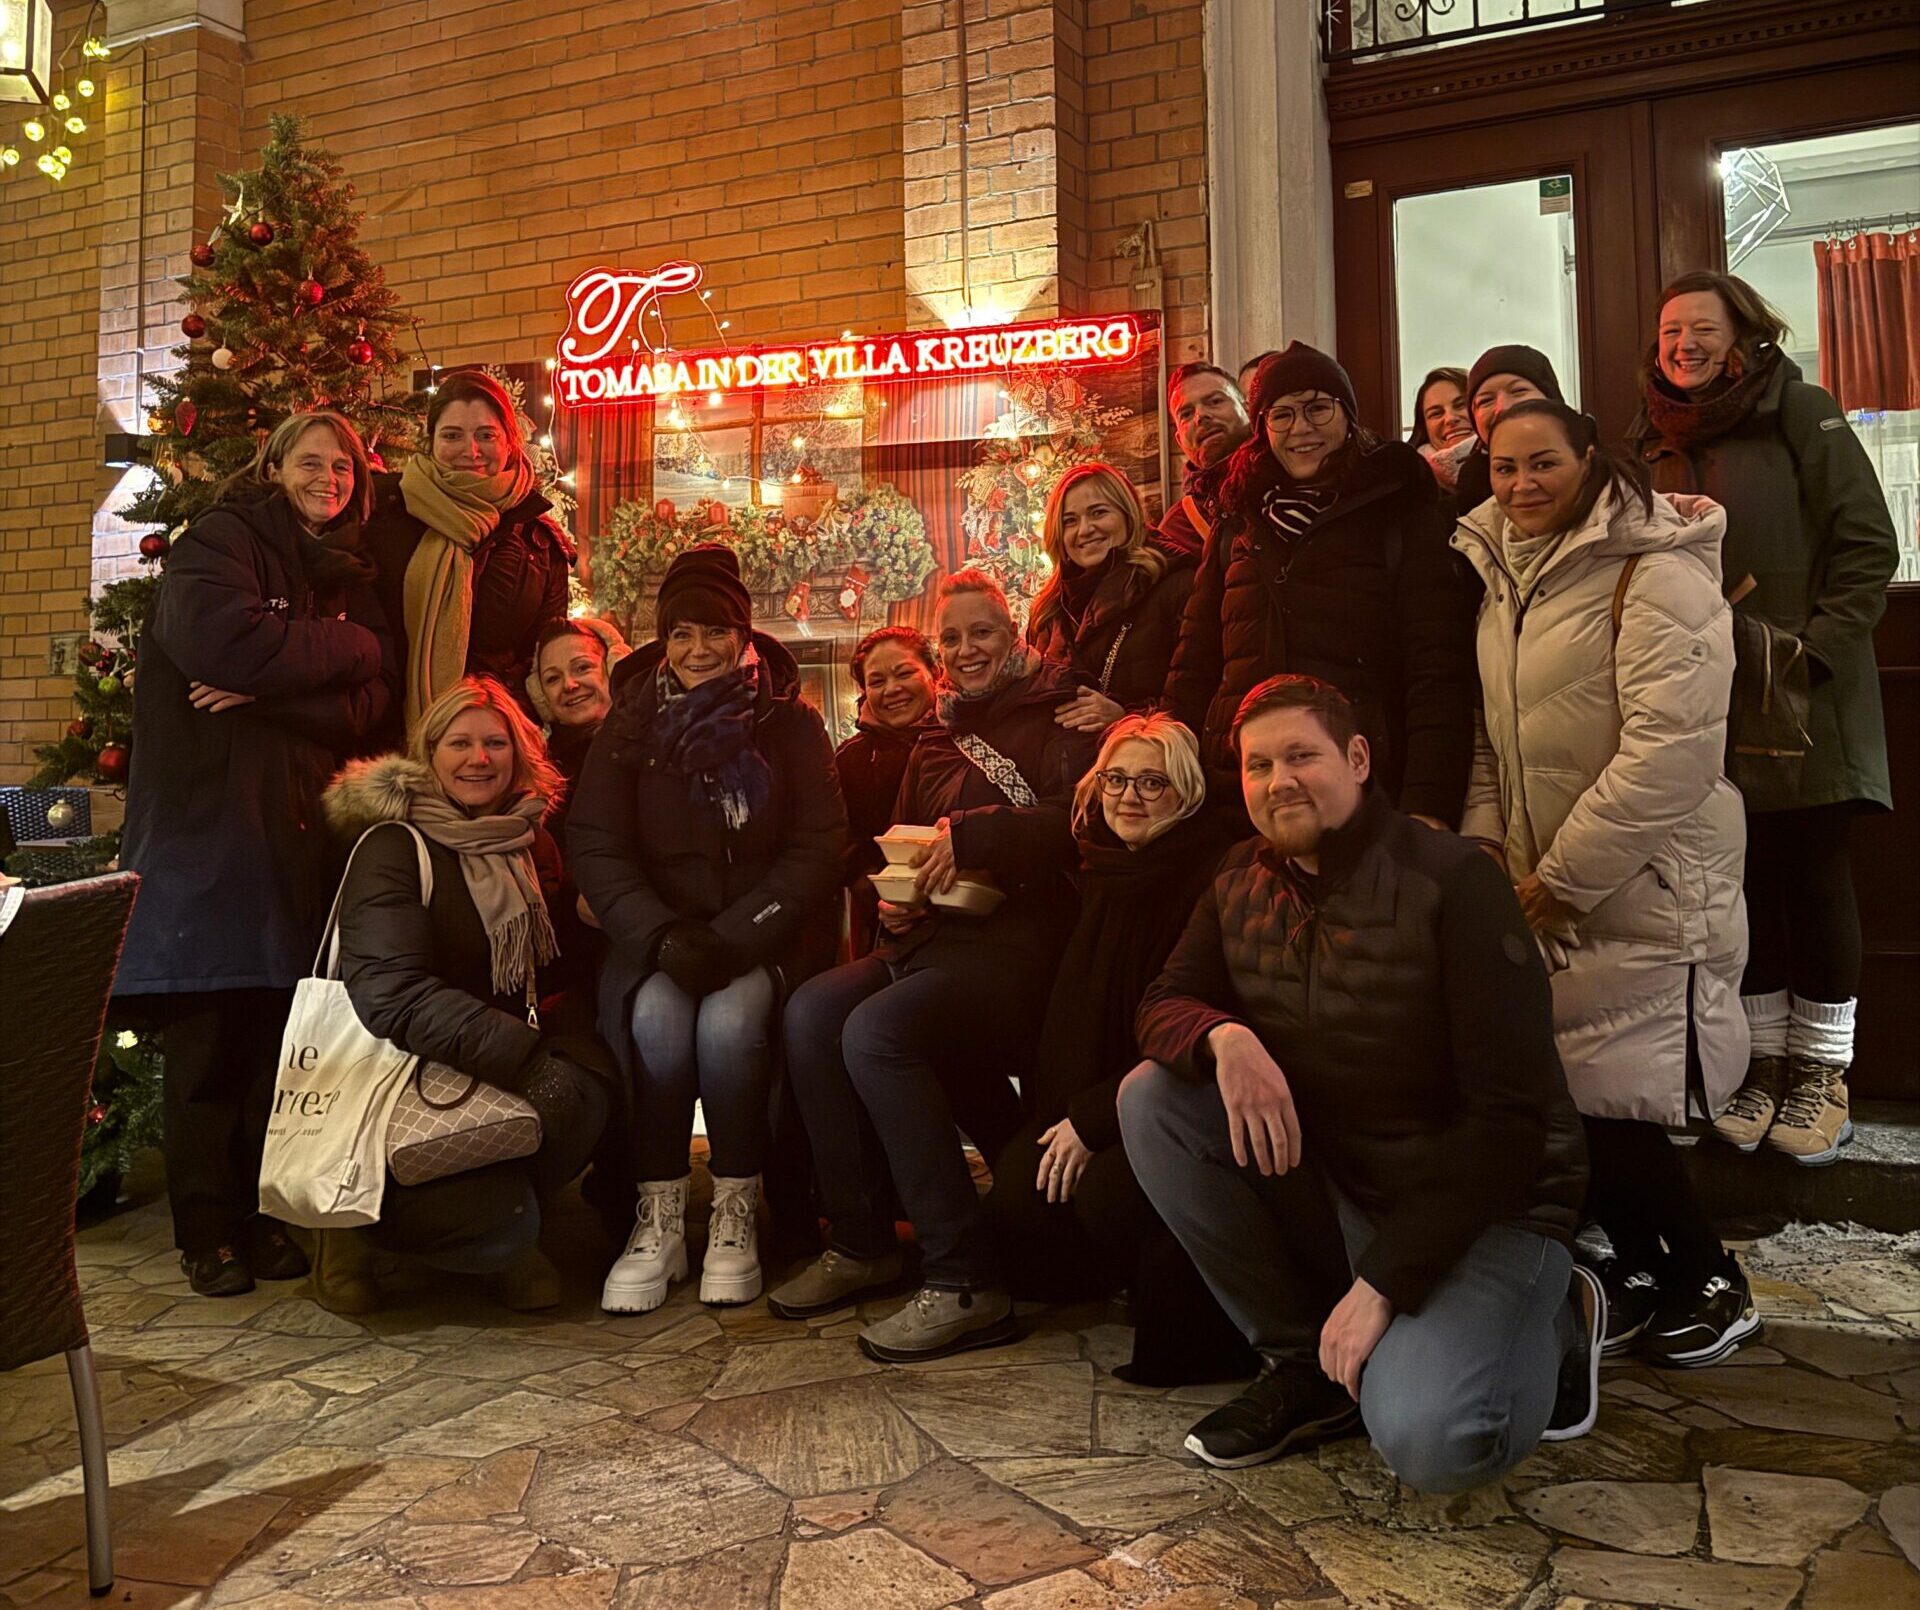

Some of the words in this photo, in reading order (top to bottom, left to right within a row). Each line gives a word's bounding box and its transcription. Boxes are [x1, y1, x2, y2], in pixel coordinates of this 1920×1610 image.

[696, 356, 734, 391] IN
[736, 352, 807, 387] DER
[809, 343, 910, 379] VILLA
[915, 322, 1132, 373] KREUZBERG
